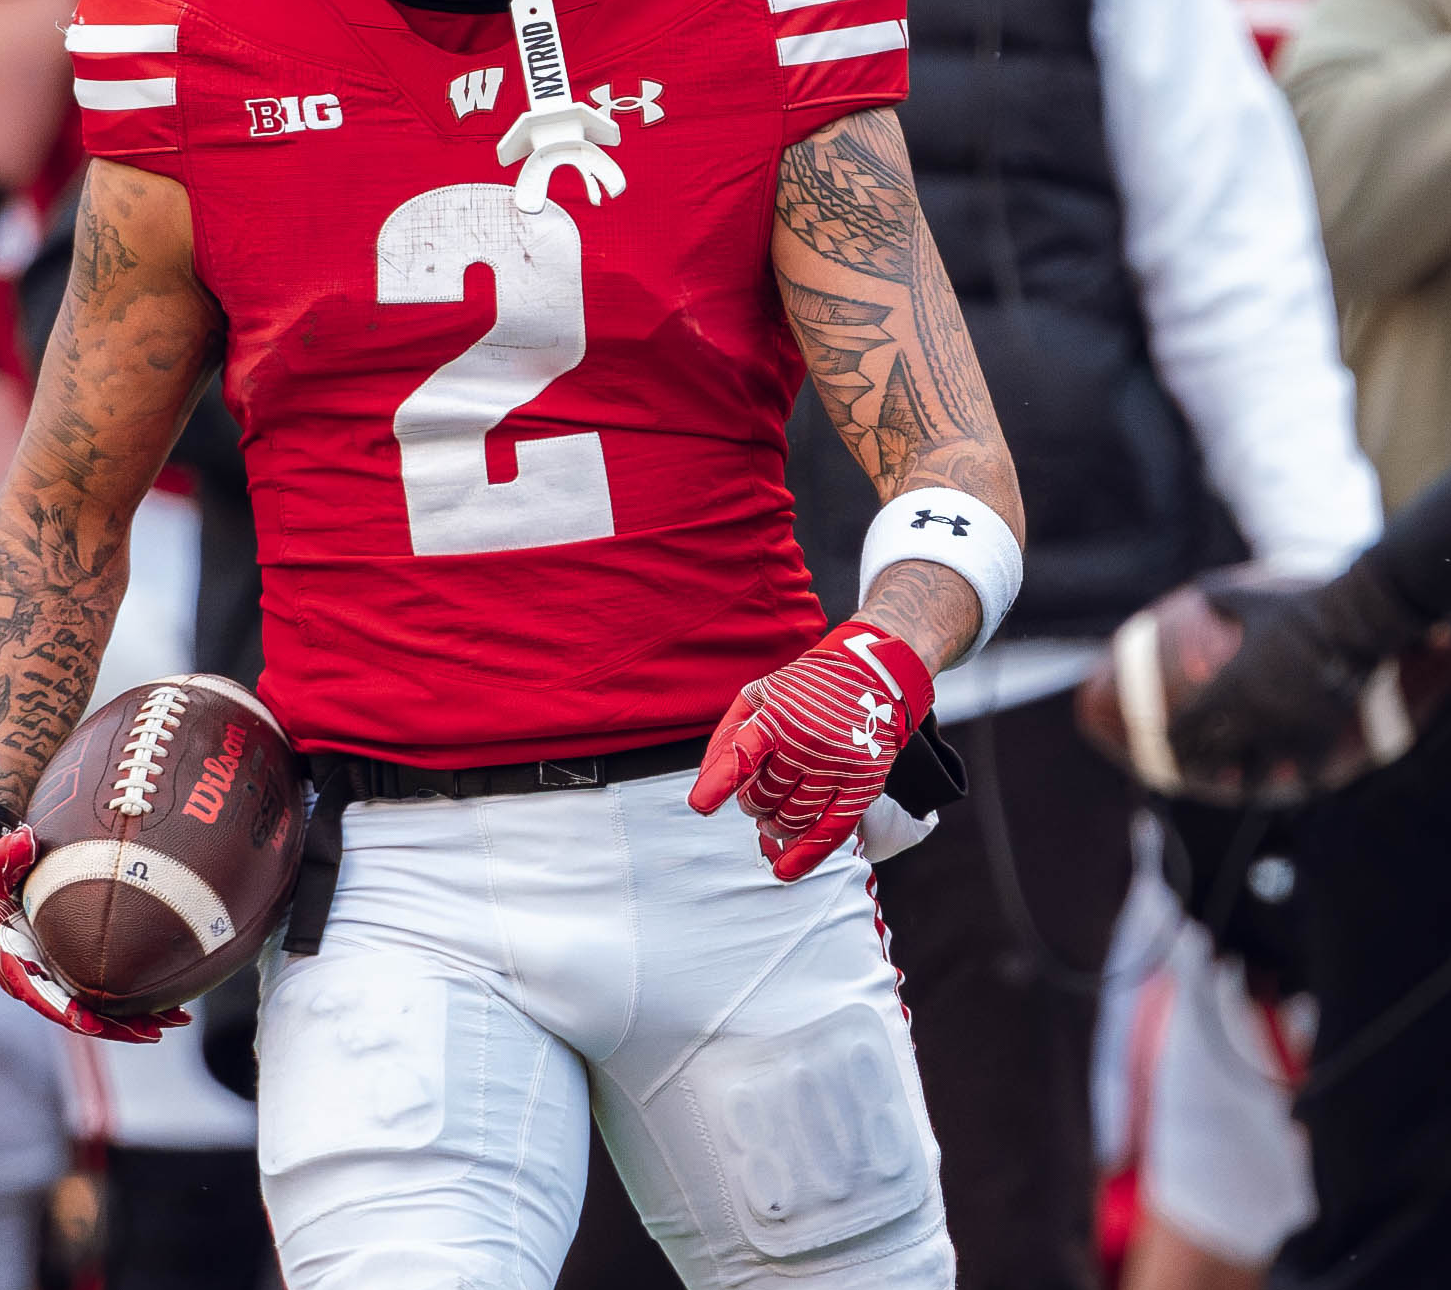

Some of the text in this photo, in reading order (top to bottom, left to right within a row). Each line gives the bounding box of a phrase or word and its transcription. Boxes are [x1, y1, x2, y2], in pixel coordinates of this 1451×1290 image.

[448, 66, 505, 120] W
[521, 21, 566, 101] NXTRND
[377, 183, 616, 557] 2
[182, 722, 247, 824] Wilson
